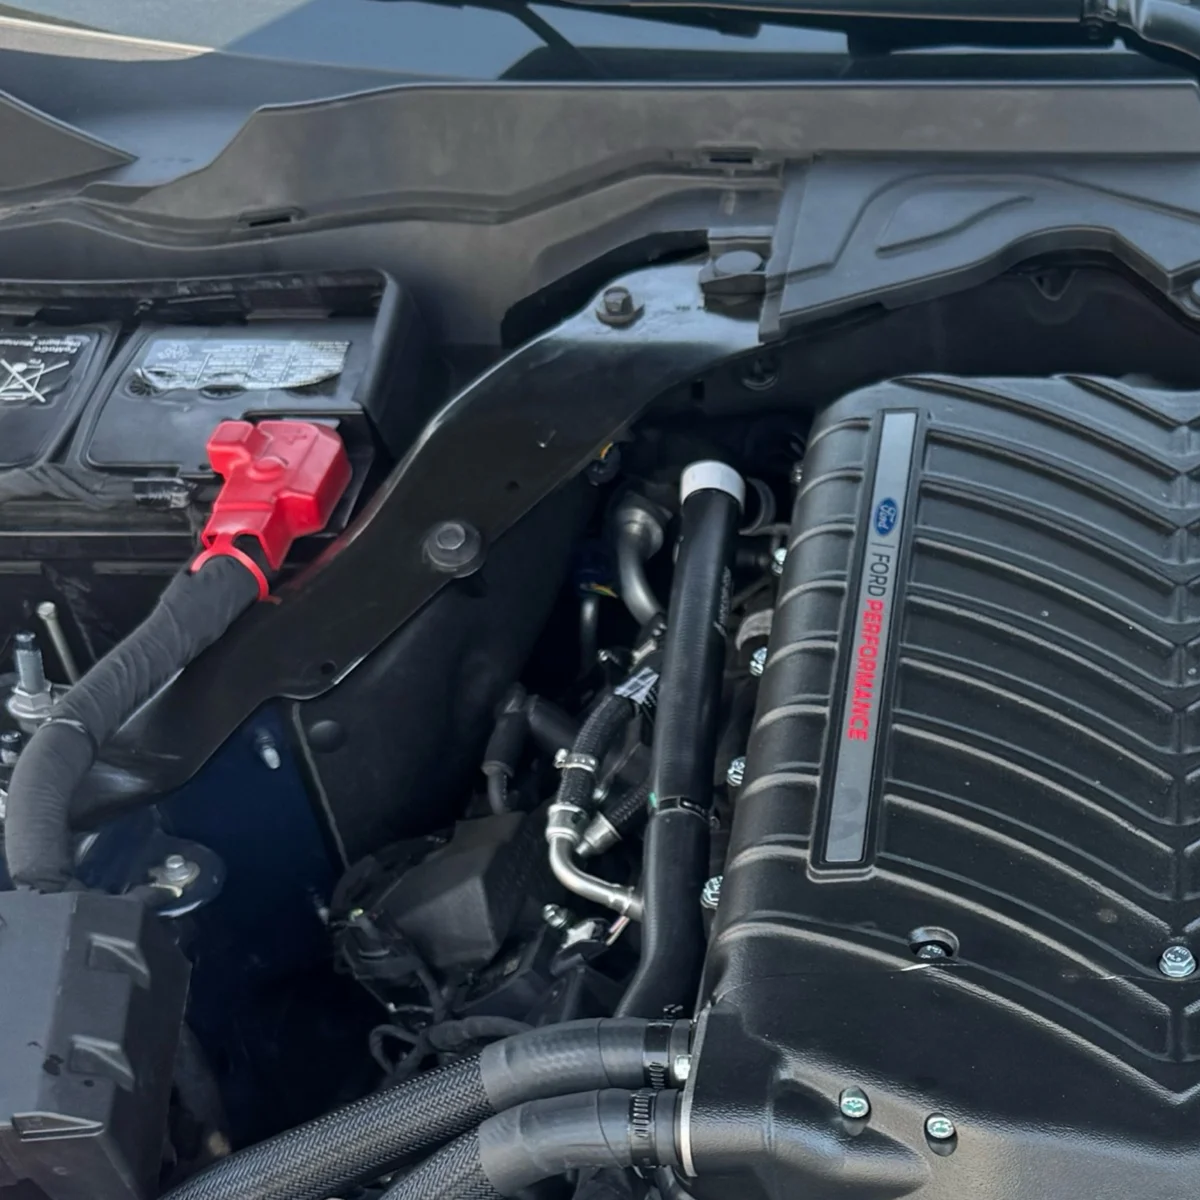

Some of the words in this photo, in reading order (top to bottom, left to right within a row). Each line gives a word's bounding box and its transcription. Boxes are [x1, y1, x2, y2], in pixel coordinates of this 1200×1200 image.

[877, 502, 897, 532] Ford
[867, 553, 891, 598] FORD
[848, 599, 885, 742] PERFORMANCE
